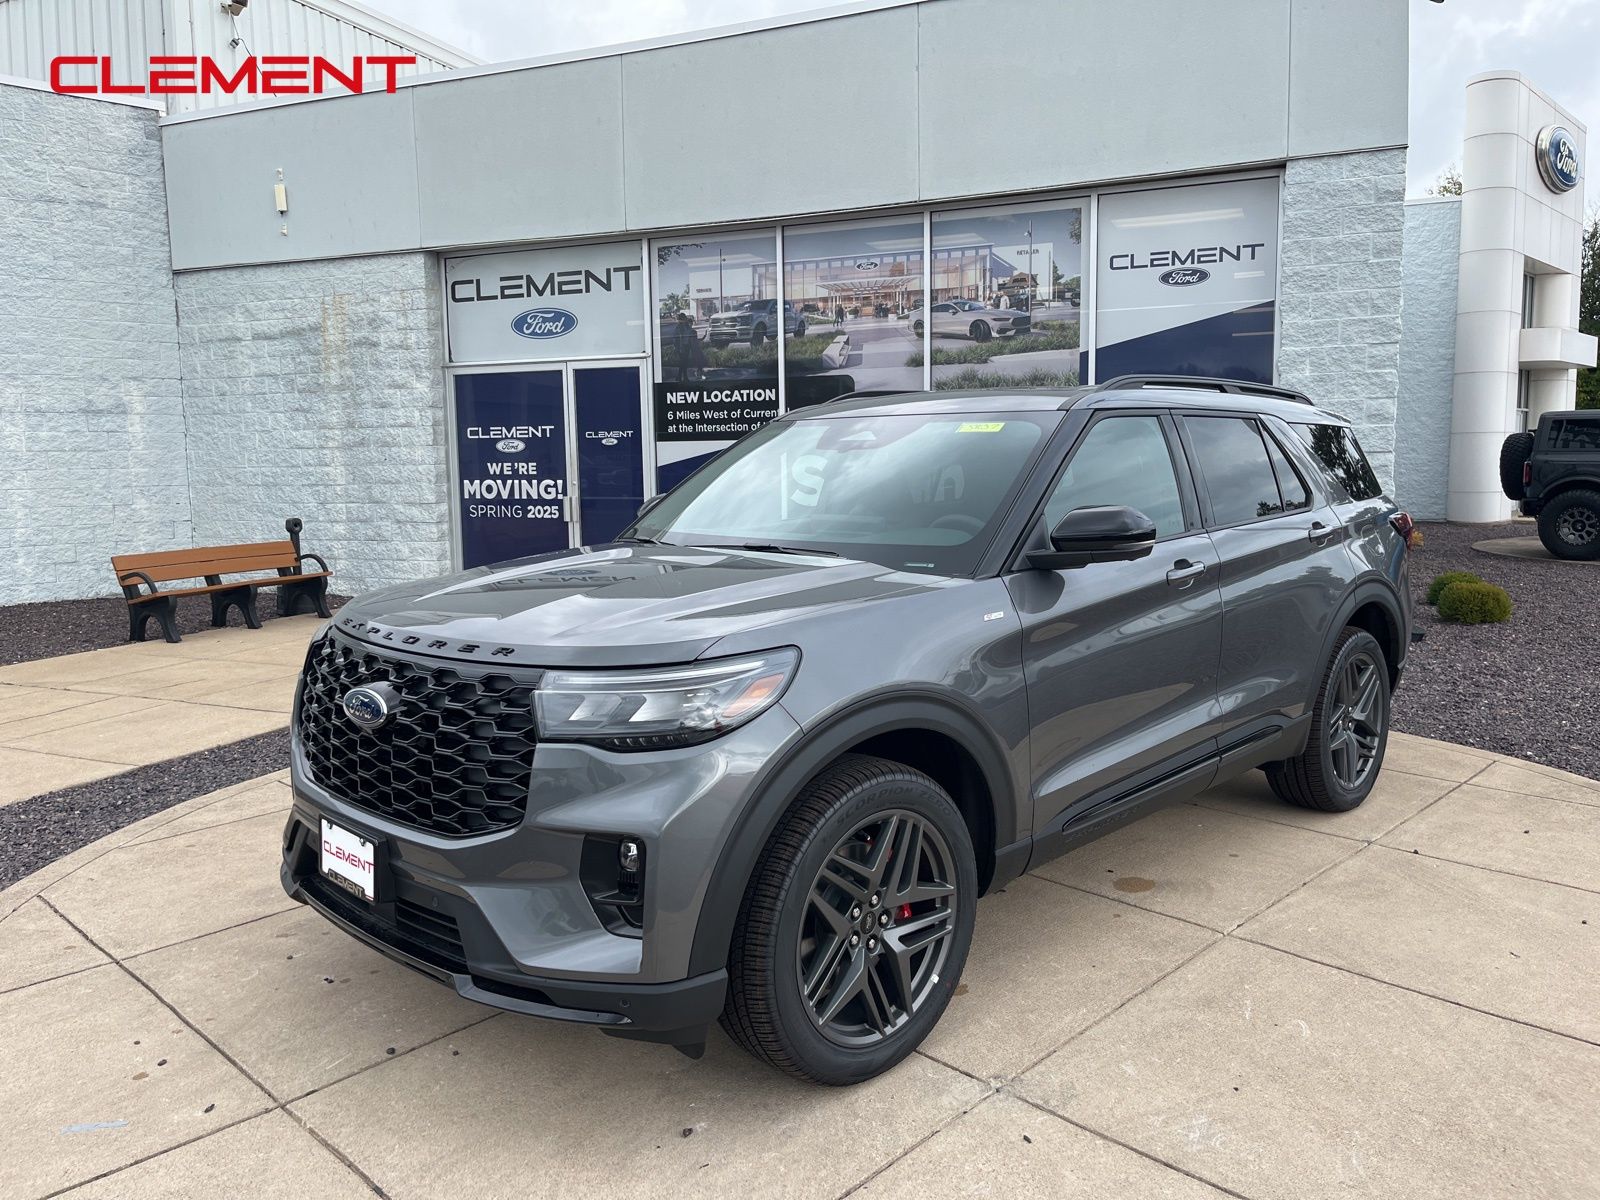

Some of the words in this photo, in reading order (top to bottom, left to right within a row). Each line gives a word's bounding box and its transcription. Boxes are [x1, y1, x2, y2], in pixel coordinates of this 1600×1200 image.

[1109, 243, 1265, 271] CLEMENT
[450, 265, 641, 303] CLEMENT
[666, 392, 700, 404] NEW
[703, 388, 776, 403] LOCATION
[667, 411, 674, 420] 6
[676, 410, 701, 421] Miles
[703, 409, 728, 419] West
[731, 408, 742, 418] of
[467, 425, 555, 439] CLEMENT
[585, 430, 634, 438] CLEMENT
[667, 423, 677, 433] at
[679, 423, 693, 433] the
[695, 422, 749, 433] Intersection
[463, 479, 564, 500] MOVING!
[469, 504, 523, 518] SPRING
[527, 505, 560, 519] 2025
[343, 617, 516, 657] EXPLORER
[323, 840, 376, 874] CLEMENT
